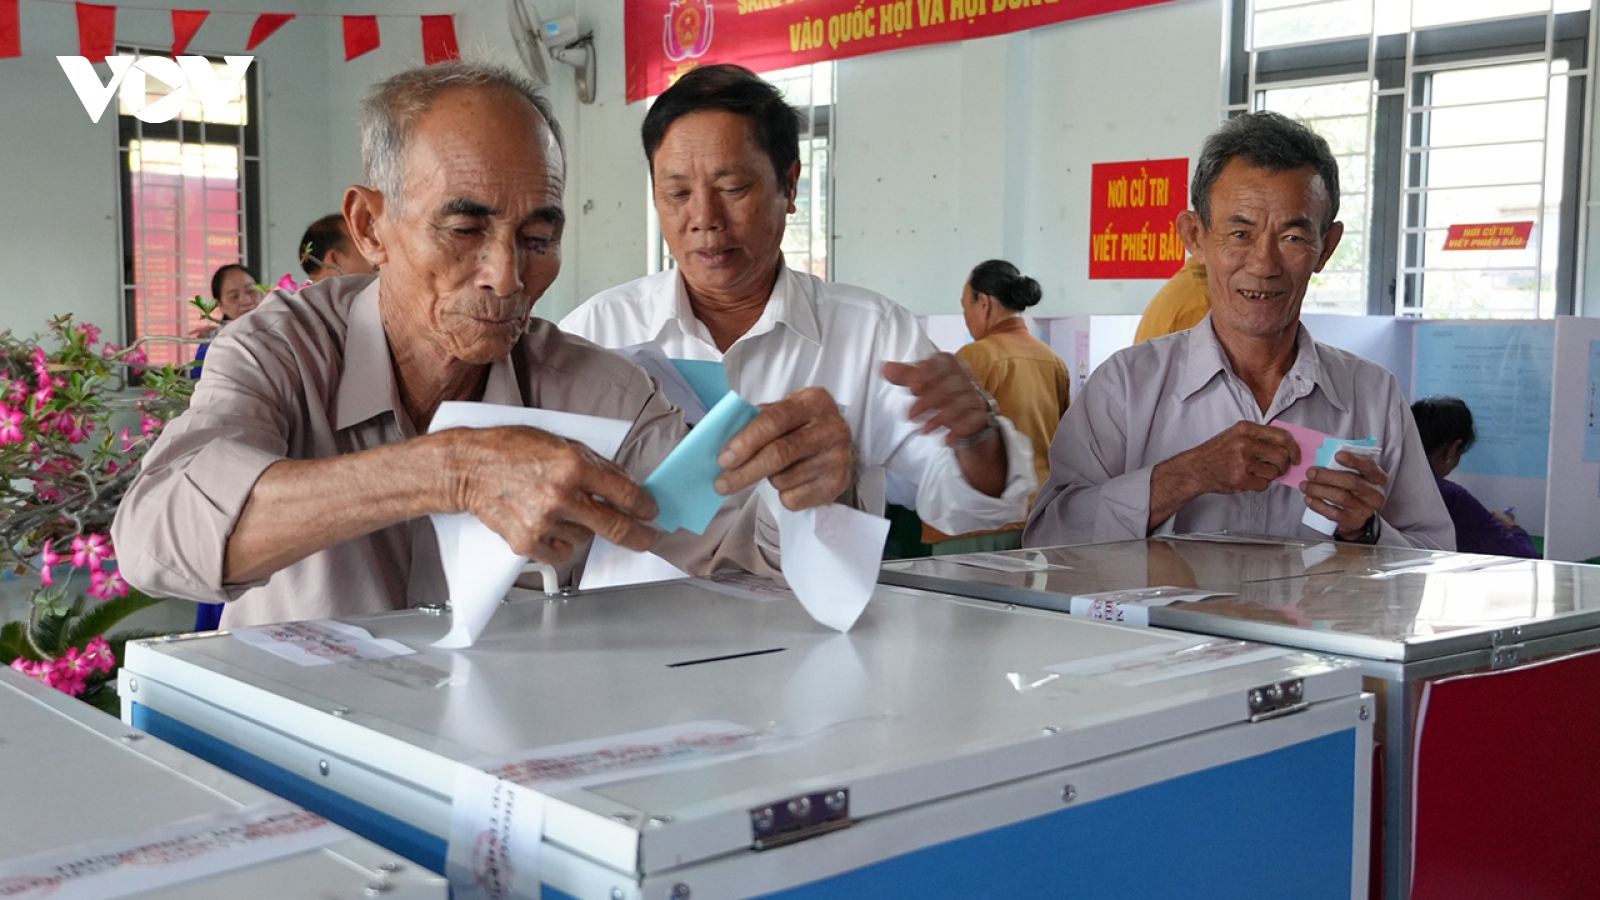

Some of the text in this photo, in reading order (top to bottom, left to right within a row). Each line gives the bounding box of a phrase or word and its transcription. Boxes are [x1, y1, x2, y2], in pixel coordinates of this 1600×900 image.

[789, 16, 824, 52] VÀO
[828, 0, 875, 50] QUỐC
[1108, 166, 1169, 208] NƠI CỬ TRI
[1093, 221, 1184, 262] VIẾT PHIẾU BẦU
[1499, 227, 1514, 236] TRI
